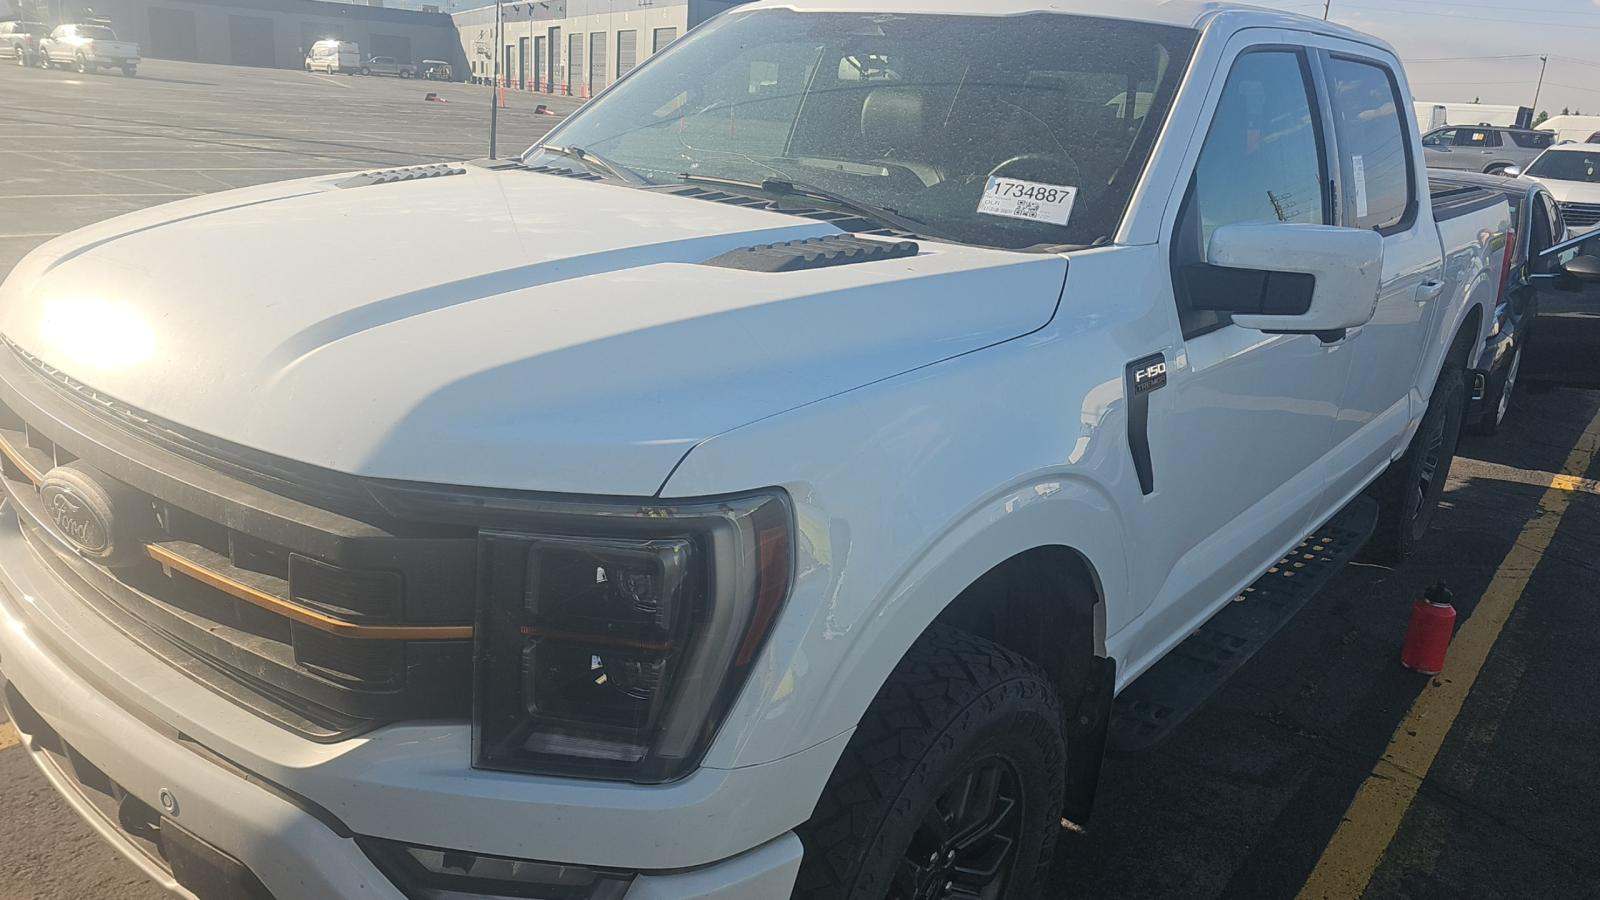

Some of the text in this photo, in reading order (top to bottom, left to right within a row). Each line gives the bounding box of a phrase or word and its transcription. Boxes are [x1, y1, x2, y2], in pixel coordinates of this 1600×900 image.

[994, 181, 1070, 204] 1734887
[1136, 362, 1166, 383] F-150
[52, 493, 90, 543] Ford
